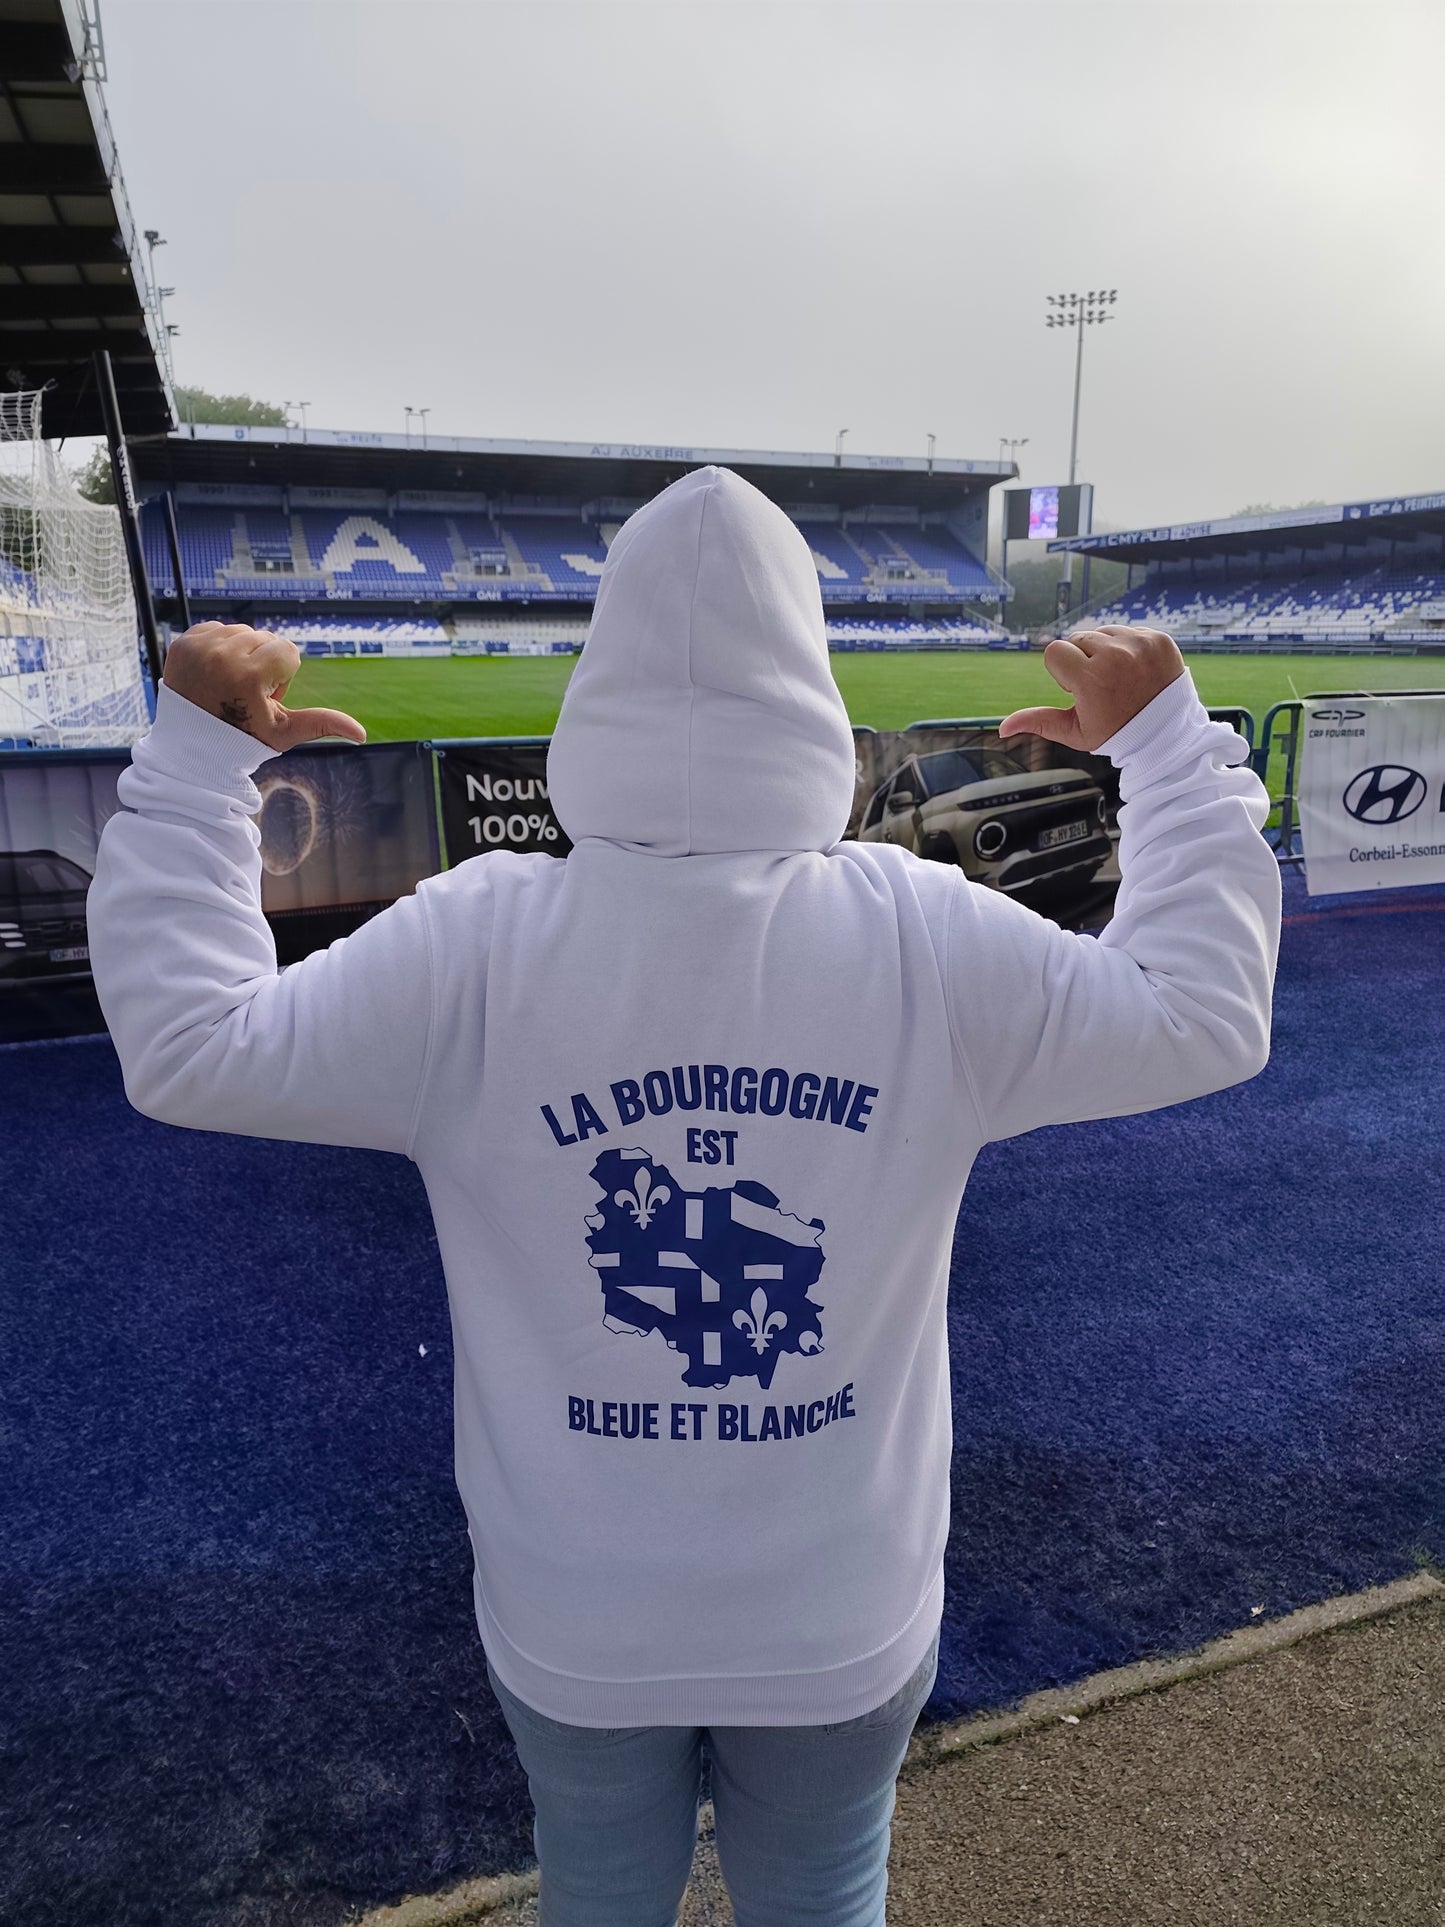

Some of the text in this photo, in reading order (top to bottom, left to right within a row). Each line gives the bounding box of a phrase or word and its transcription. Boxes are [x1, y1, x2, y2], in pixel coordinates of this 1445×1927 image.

[590, 446, 694, 460] AJ AUXERRE
[1325, 728, 1366, 738] FOURNIER
[467, 814, 559, 844] 100%
[540, 1064, 880, 1147] LA BOURGOGNE
[686, 1127, 739, 1166] EST
[568, 1382, 856, 1442] BLEUE ET BLANCHE
